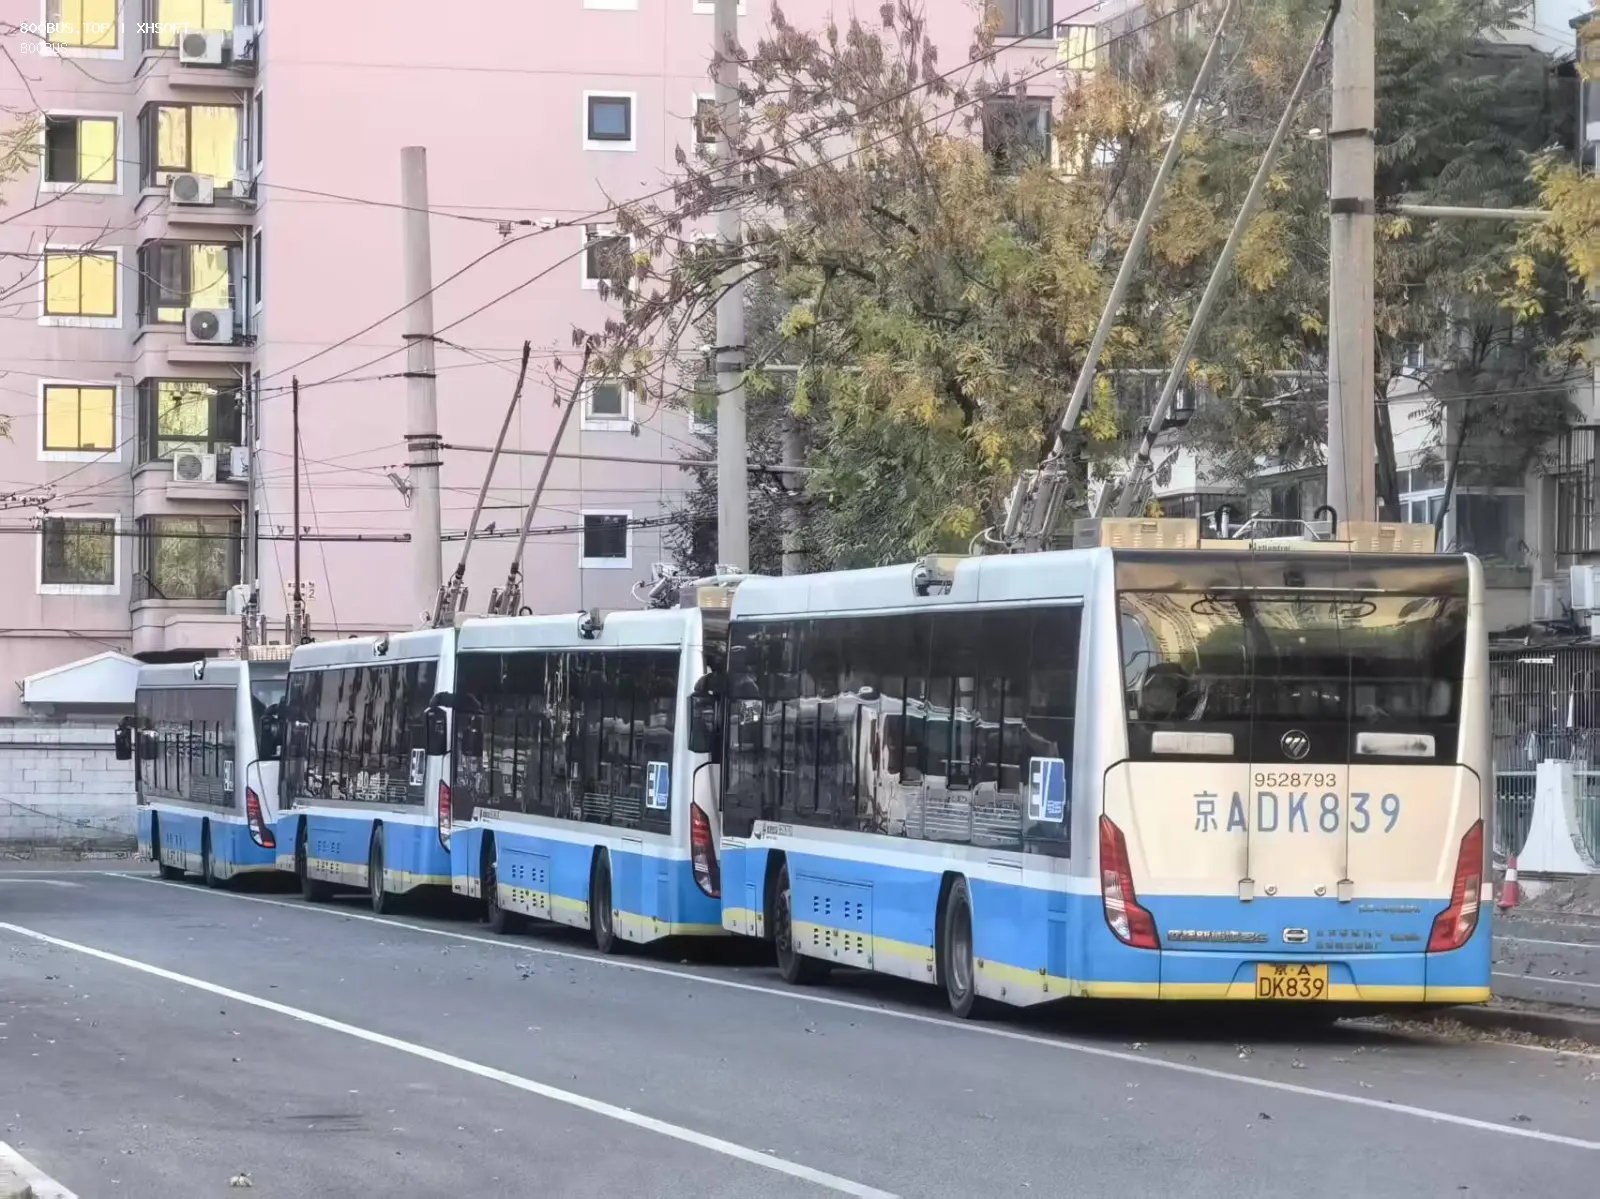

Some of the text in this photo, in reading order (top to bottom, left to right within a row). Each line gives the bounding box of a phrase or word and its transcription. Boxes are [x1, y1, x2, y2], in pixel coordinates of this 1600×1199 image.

[1254, 772, 1337, 788] 9528793
[1193, 790, 1401, 833] 京ADK839
[1259, 976, 1325, 998] DK839
